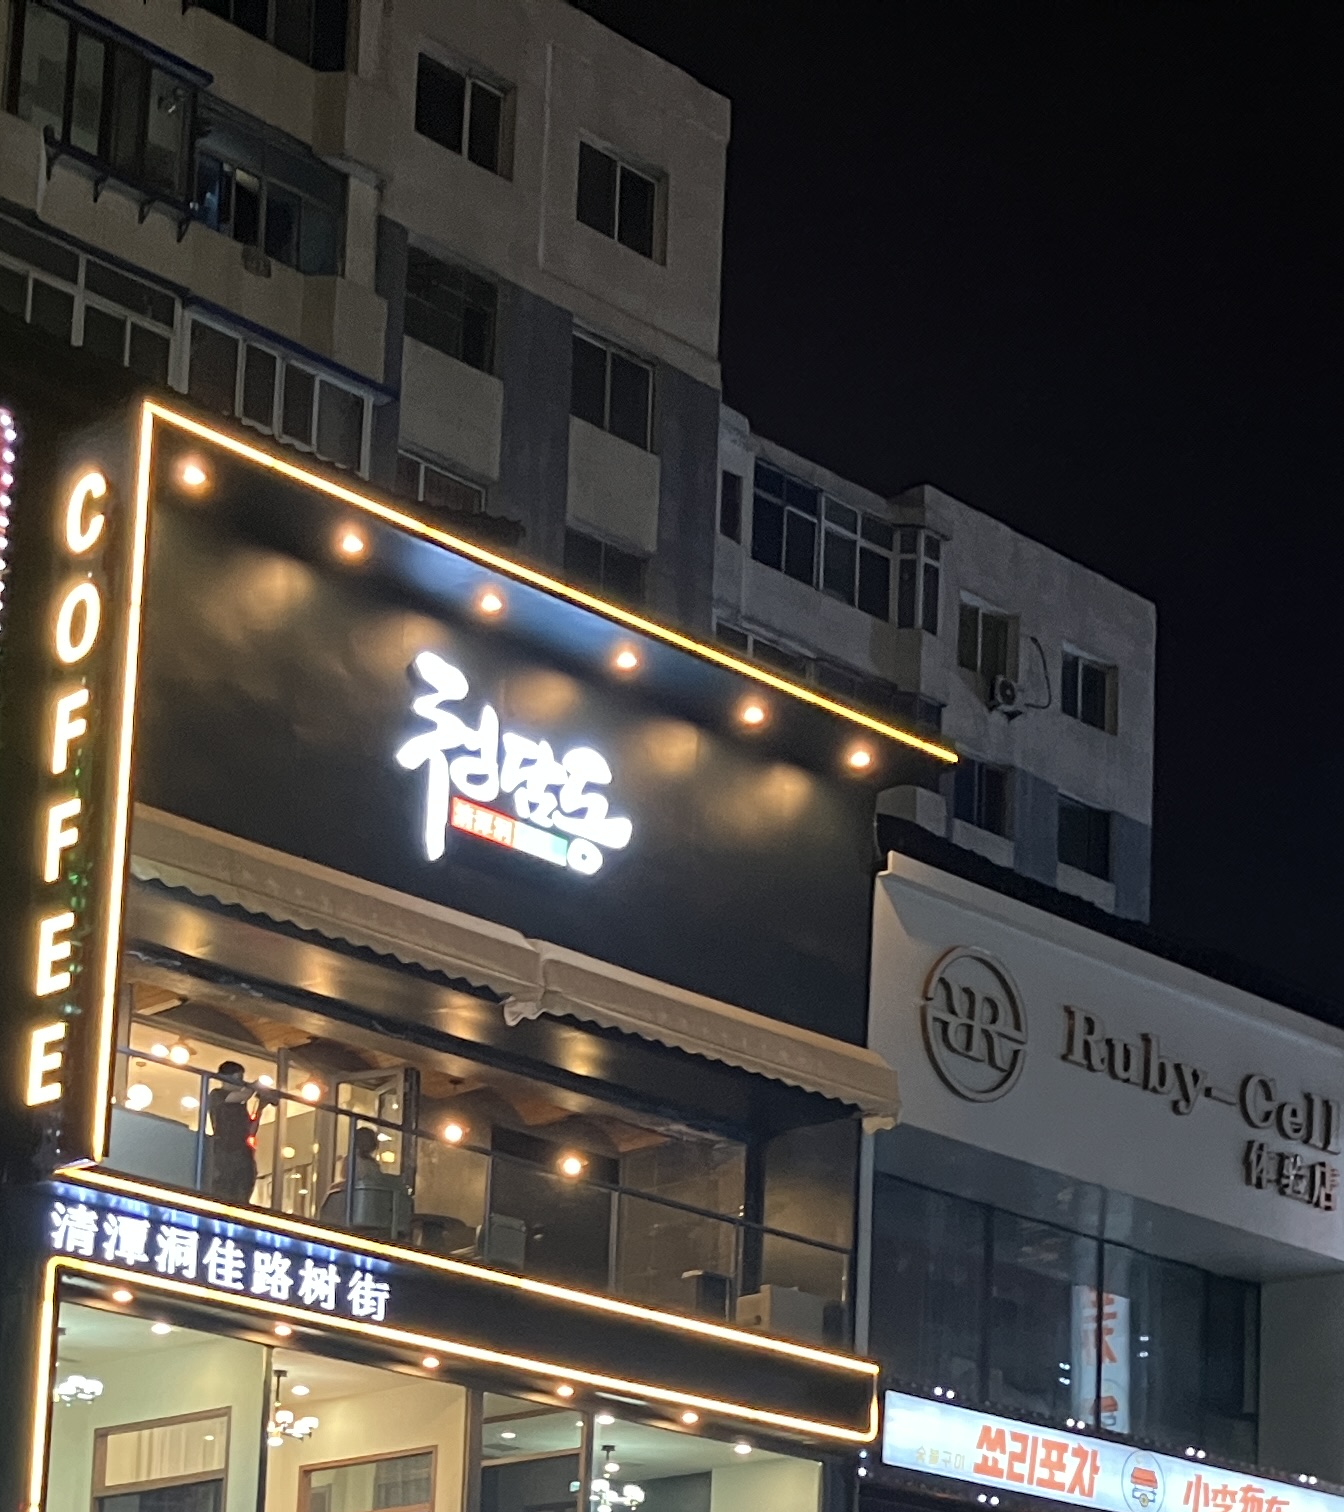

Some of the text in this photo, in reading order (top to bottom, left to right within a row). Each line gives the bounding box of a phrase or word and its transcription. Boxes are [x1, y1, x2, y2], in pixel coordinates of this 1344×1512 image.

[23, 468, 109, 1109] COFFEE
[1062, 1005, 1341, 1154] Ruby-Cell
[1242, 1140, 1339, 1211] 体验店
[51, 1201, 392, 1322] 清潭洞佳路树街
